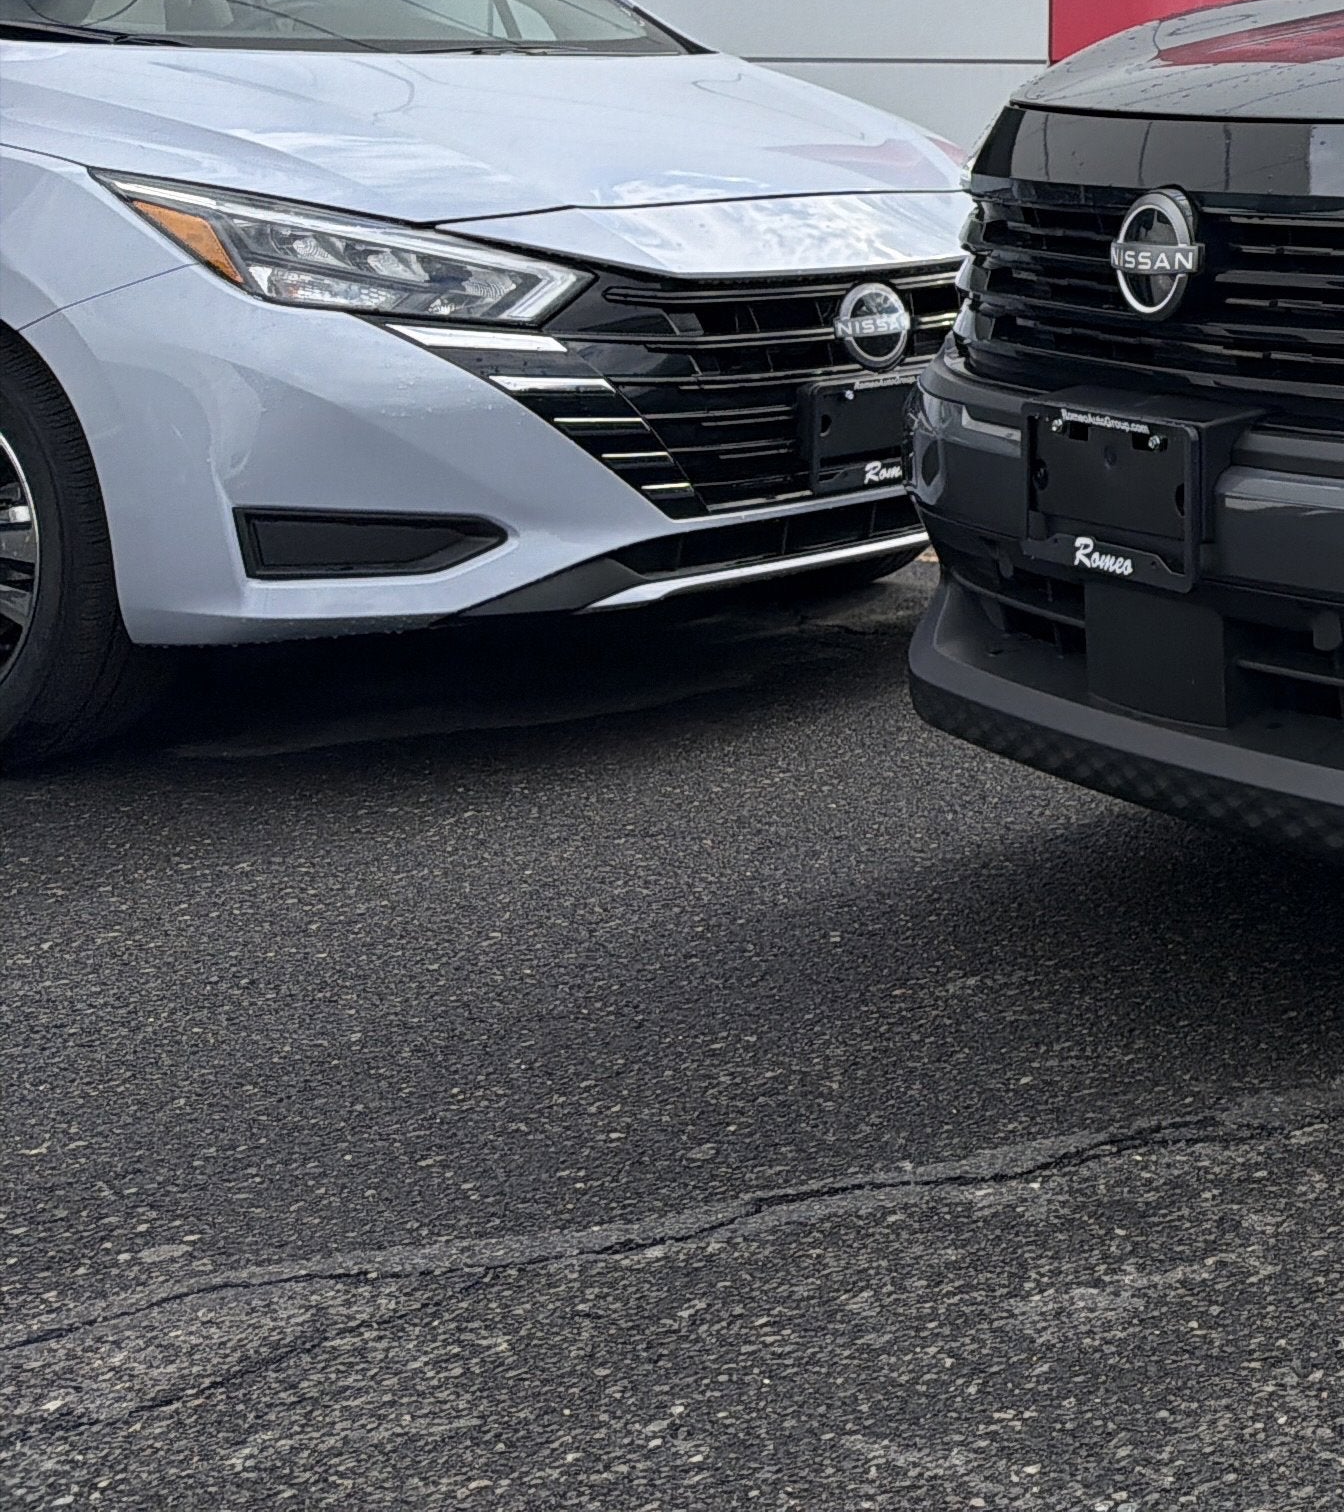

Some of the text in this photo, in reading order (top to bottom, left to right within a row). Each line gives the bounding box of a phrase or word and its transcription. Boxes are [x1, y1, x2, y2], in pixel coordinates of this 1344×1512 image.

[1111, 247, 1194, 270] NISSAN
[836, 314, 907, 338] NISSA
[864, 460, 903, 485] Rom
[1073, 536, 1134, 576] Romeo
